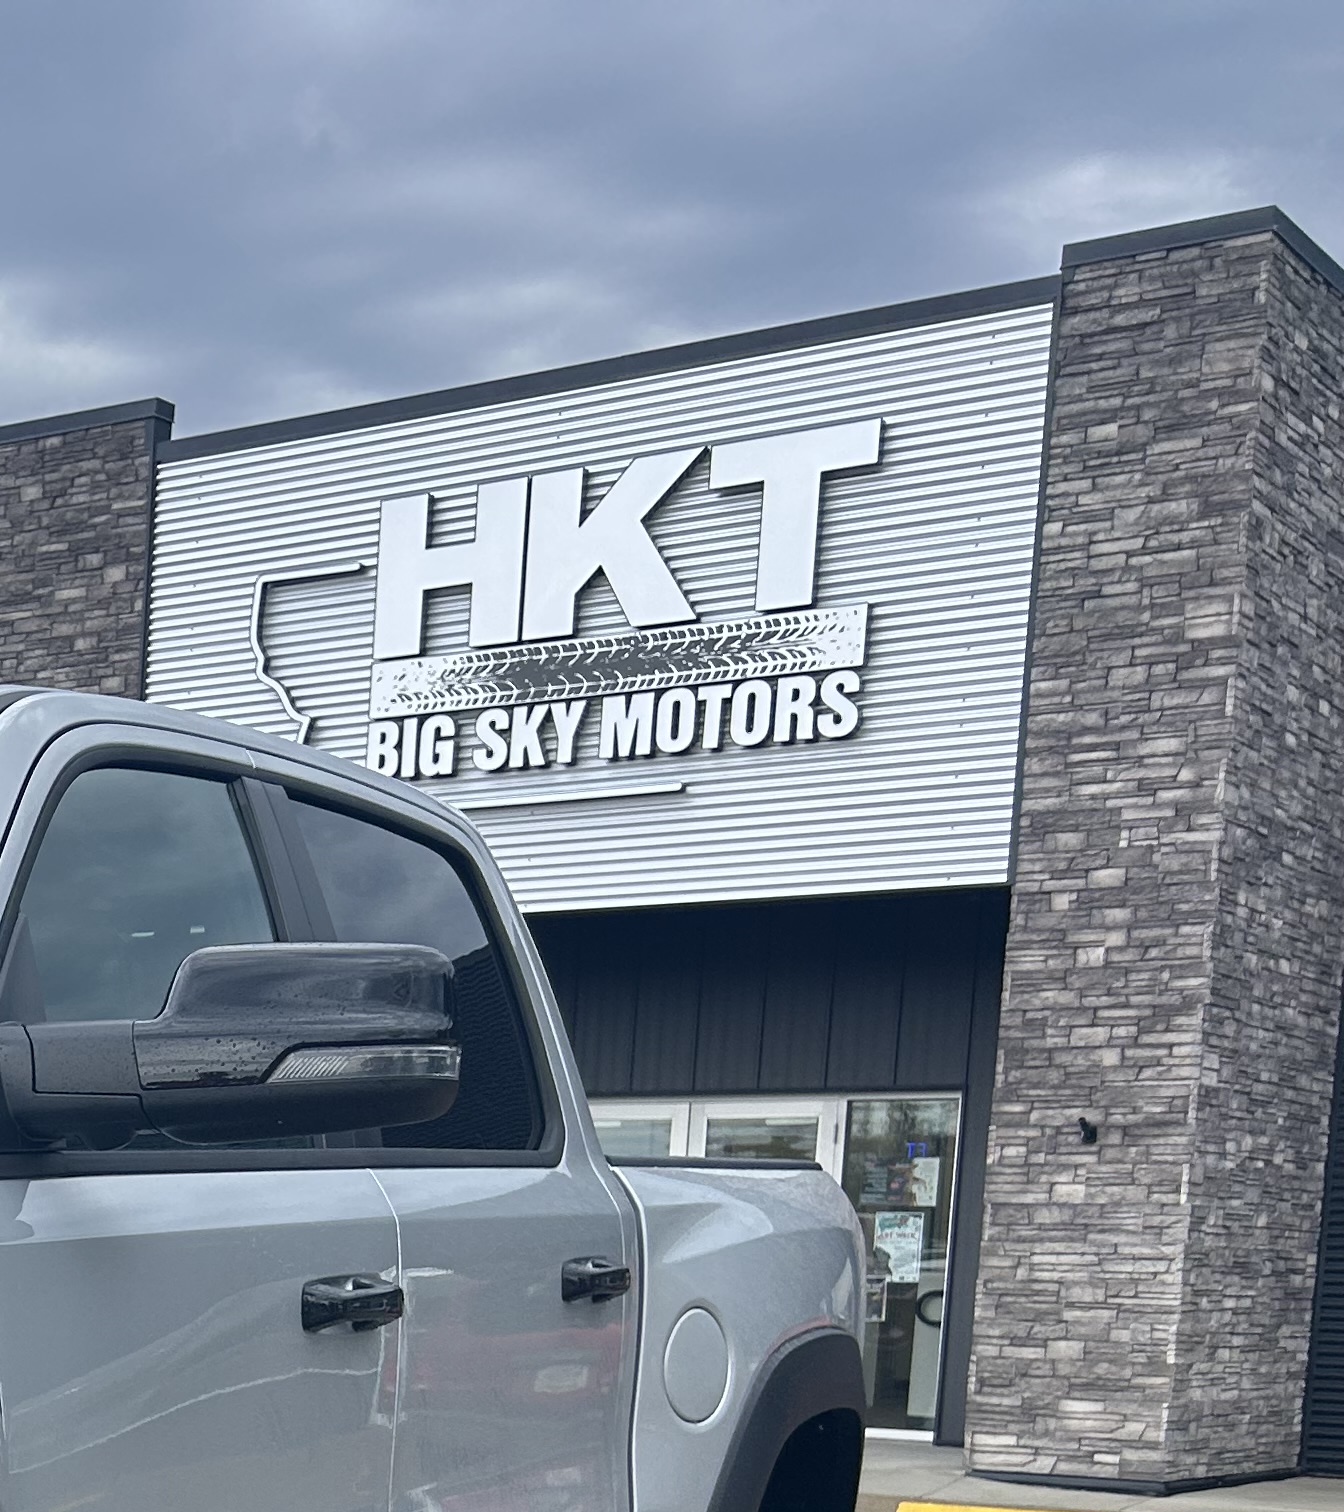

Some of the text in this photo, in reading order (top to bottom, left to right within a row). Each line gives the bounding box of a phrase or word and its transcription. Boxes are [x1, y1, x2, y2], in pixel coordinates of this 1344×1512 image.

[373, 417, 884, 660] HKT
[366, 670, 861, 780] BIG SKY MOTORS
